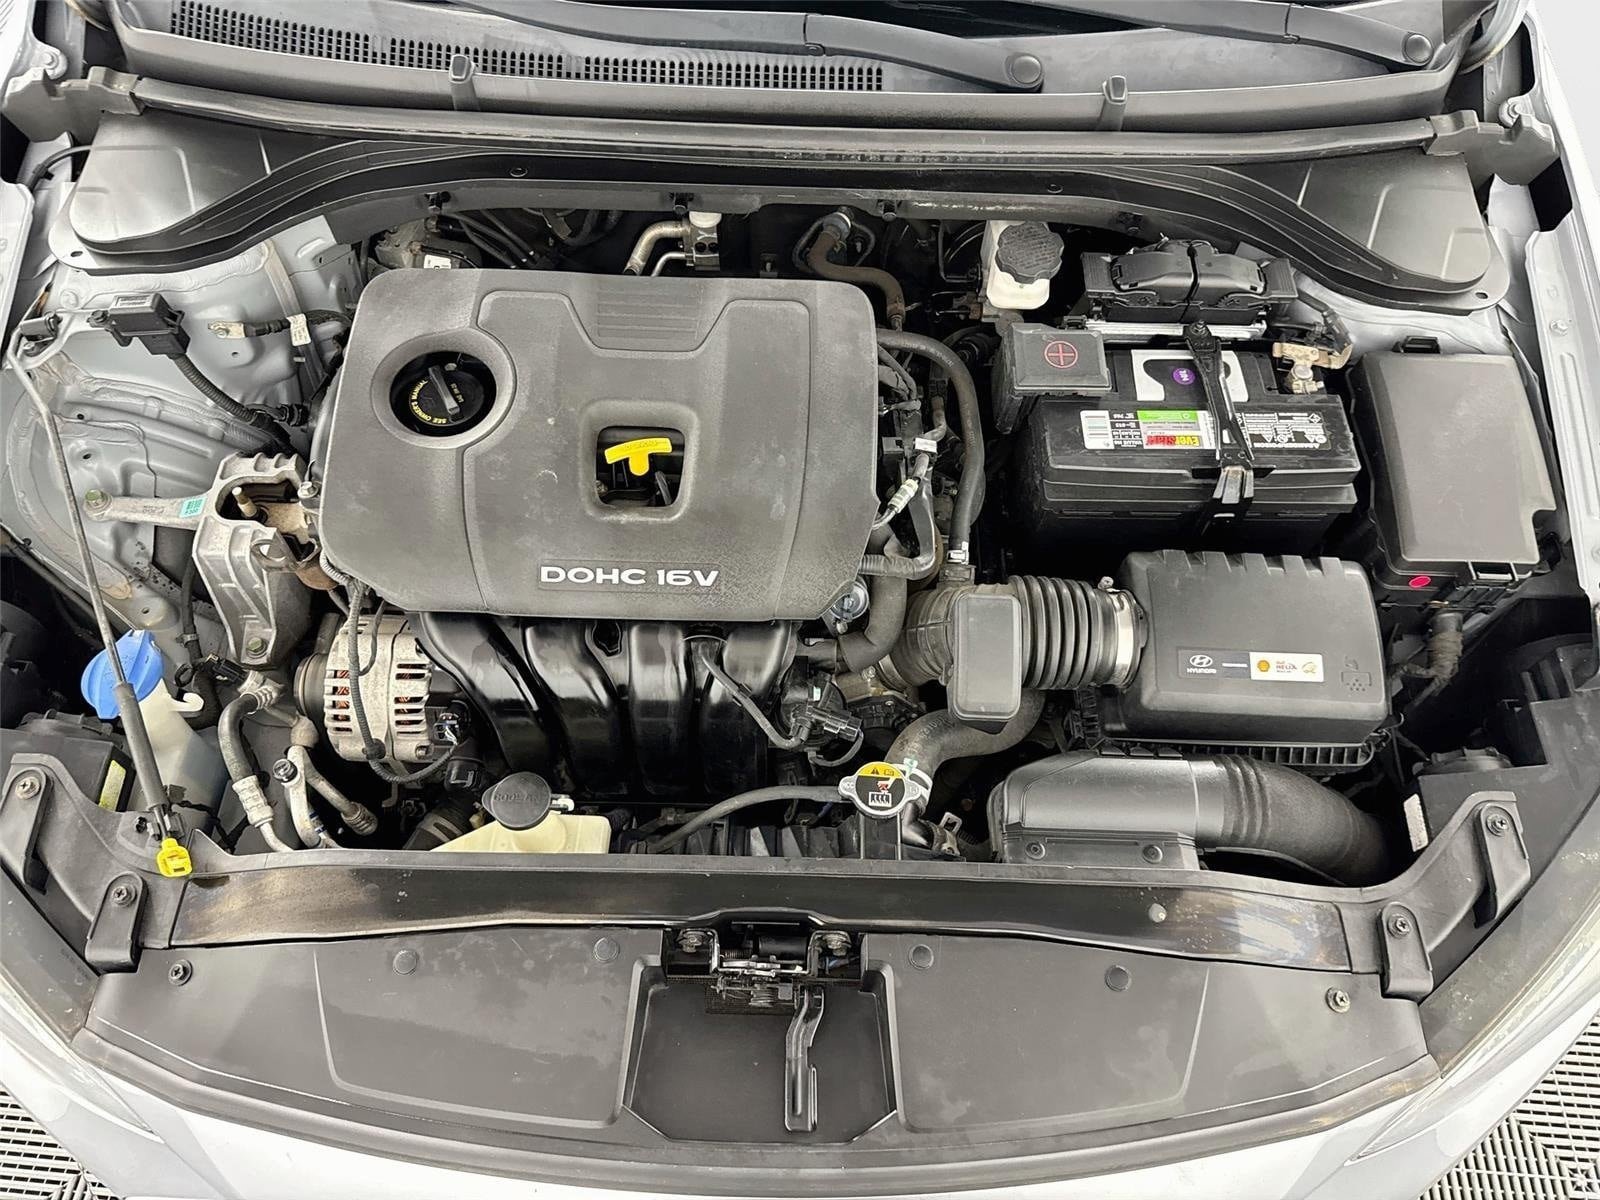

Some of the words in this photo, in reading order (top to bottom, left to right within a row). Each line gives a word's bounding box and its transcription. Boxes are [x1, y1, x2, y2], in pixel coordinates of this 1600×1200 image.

[540, 566, 646, 585] DOHC
[656, 569, 719, 587] 16V
[1186, 667, 1217, 675] HYUNDAI
